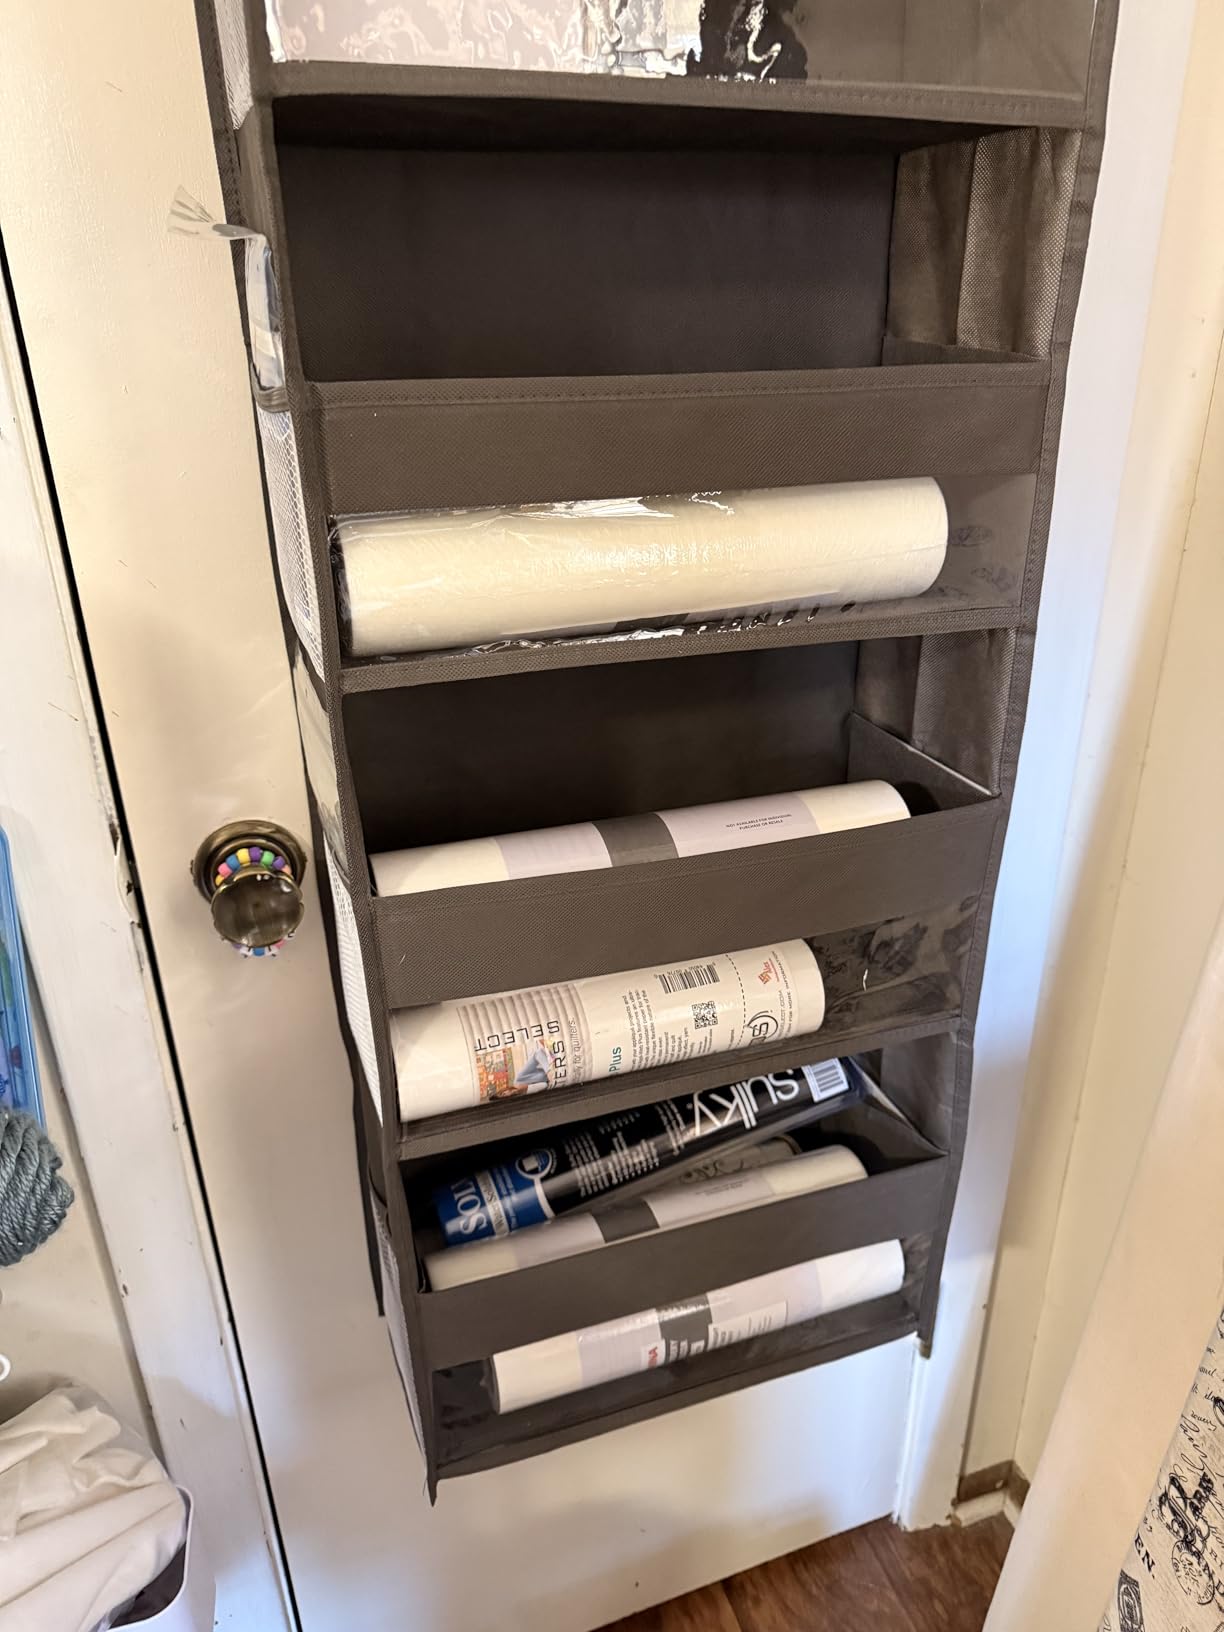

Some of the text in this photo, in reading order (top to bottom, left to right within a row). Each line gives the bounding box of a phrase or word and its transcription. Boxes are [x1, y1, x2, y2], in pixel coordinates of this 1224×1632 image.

[772, 950, 790, 989] INFORMATION
[625, 1006, 634, 1026] projects
[474, 1020, 560, 1052] SELECT
[553, 1040, 567, 1090] TERS
[573, 1053, 584, 1066] for
[609, 1046, 621, 1073] Plus
[693, 1069, 799, 1137] sulky
